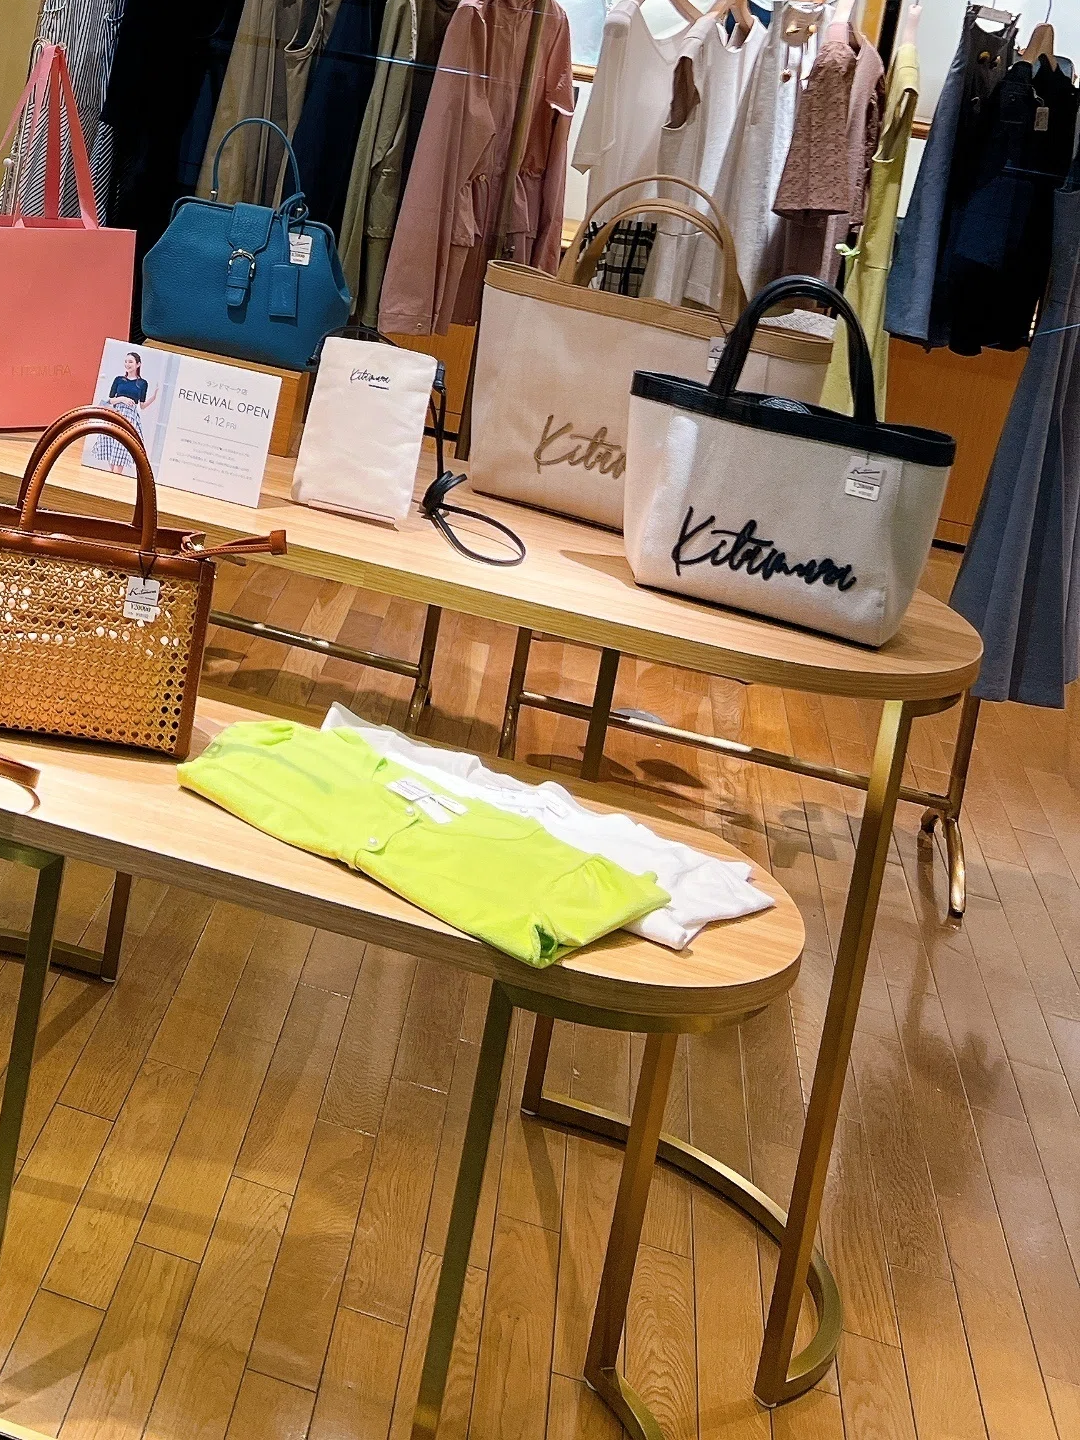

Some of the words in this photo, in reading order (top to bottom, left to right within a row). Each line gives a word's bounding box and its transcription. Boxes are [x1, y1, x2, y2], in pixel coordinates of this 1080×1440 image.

[178, 388, 234, 411] RENEWAL
[236, 402, 271, 419] OPEN
[671, 505, 857, 592] Kitamura
